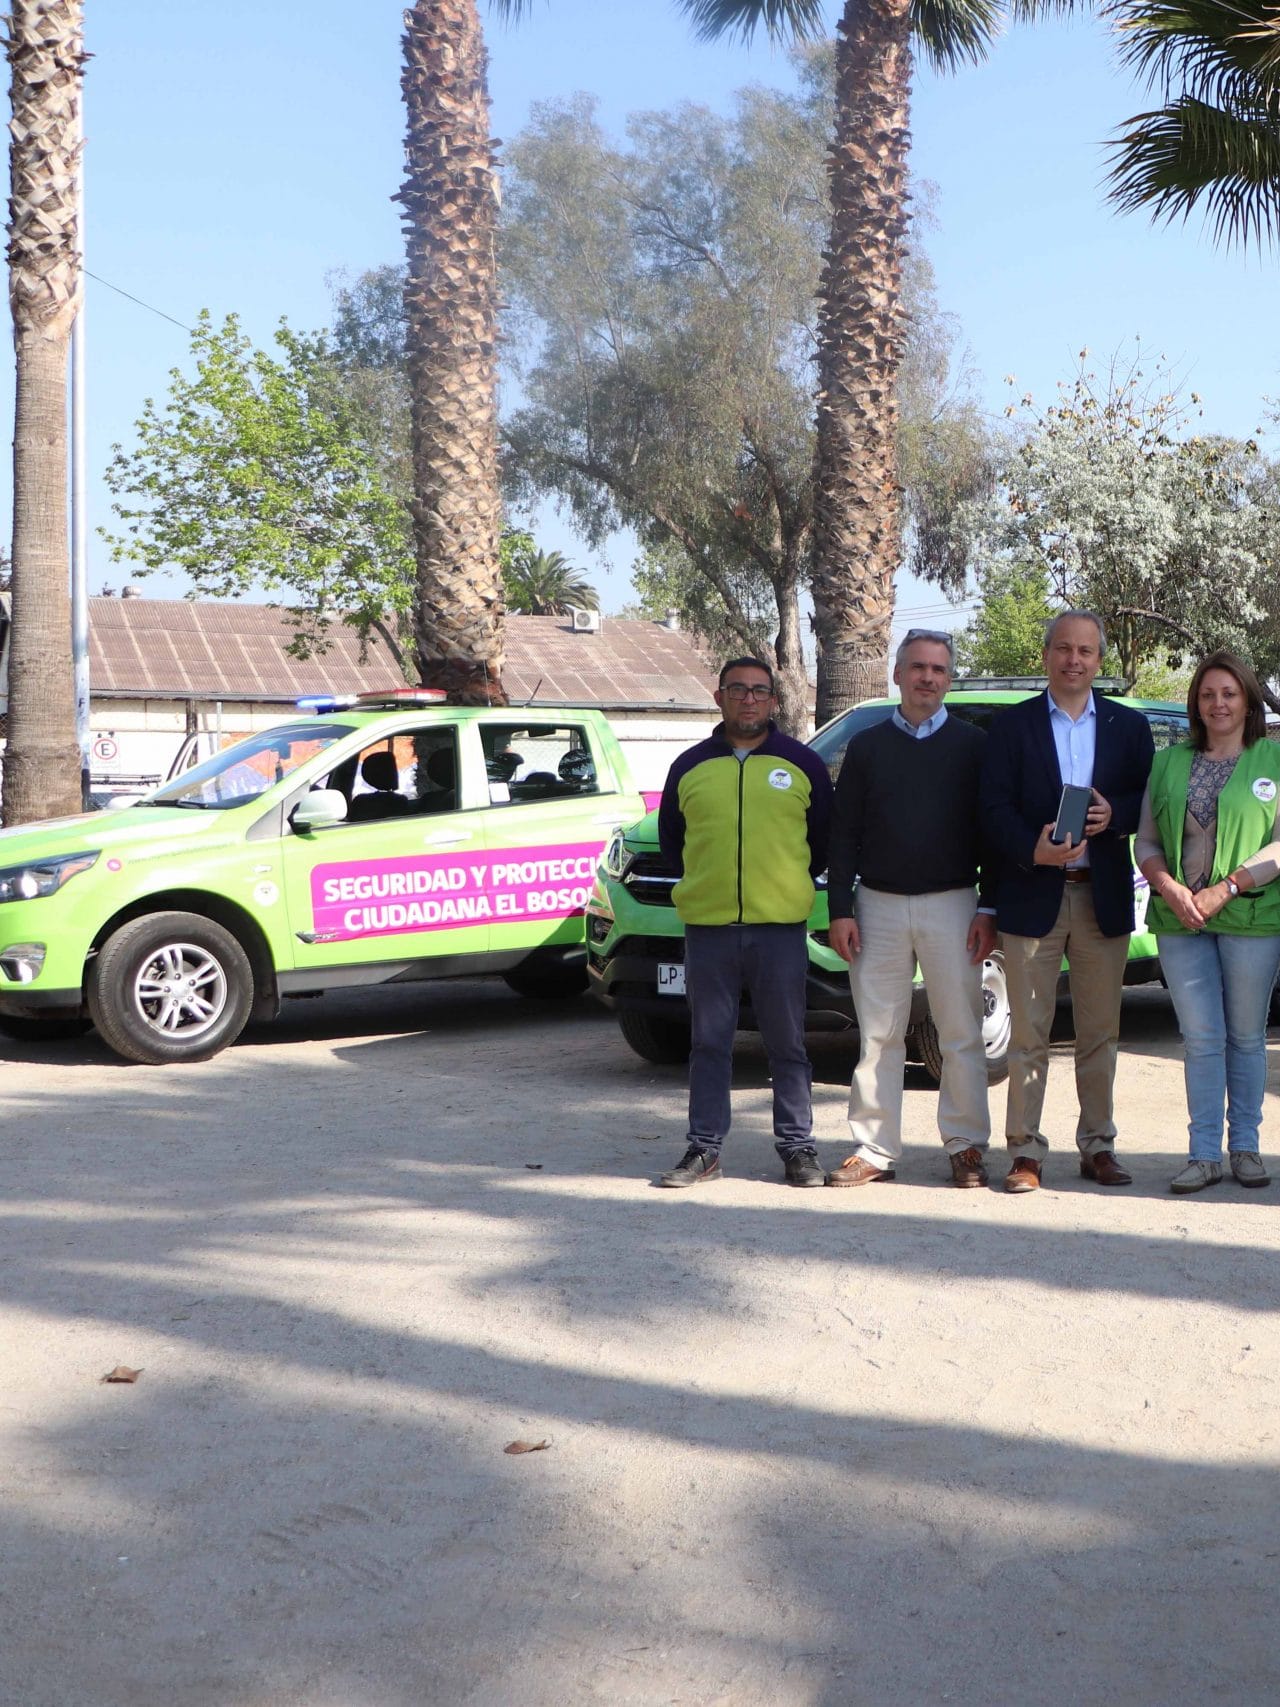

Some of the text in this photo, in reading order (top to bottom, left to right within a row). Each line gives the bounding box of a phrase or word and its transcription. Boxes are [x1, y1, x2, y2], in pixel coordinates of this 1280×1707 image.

[101, 743, 110, 756] E
[323, 867, 467, 902] SEGURIDAD
[470, 865, 487, 887] Y
[344, 895, 492, 932] CIUDADANA
[496, 893, 524, 915] EL
